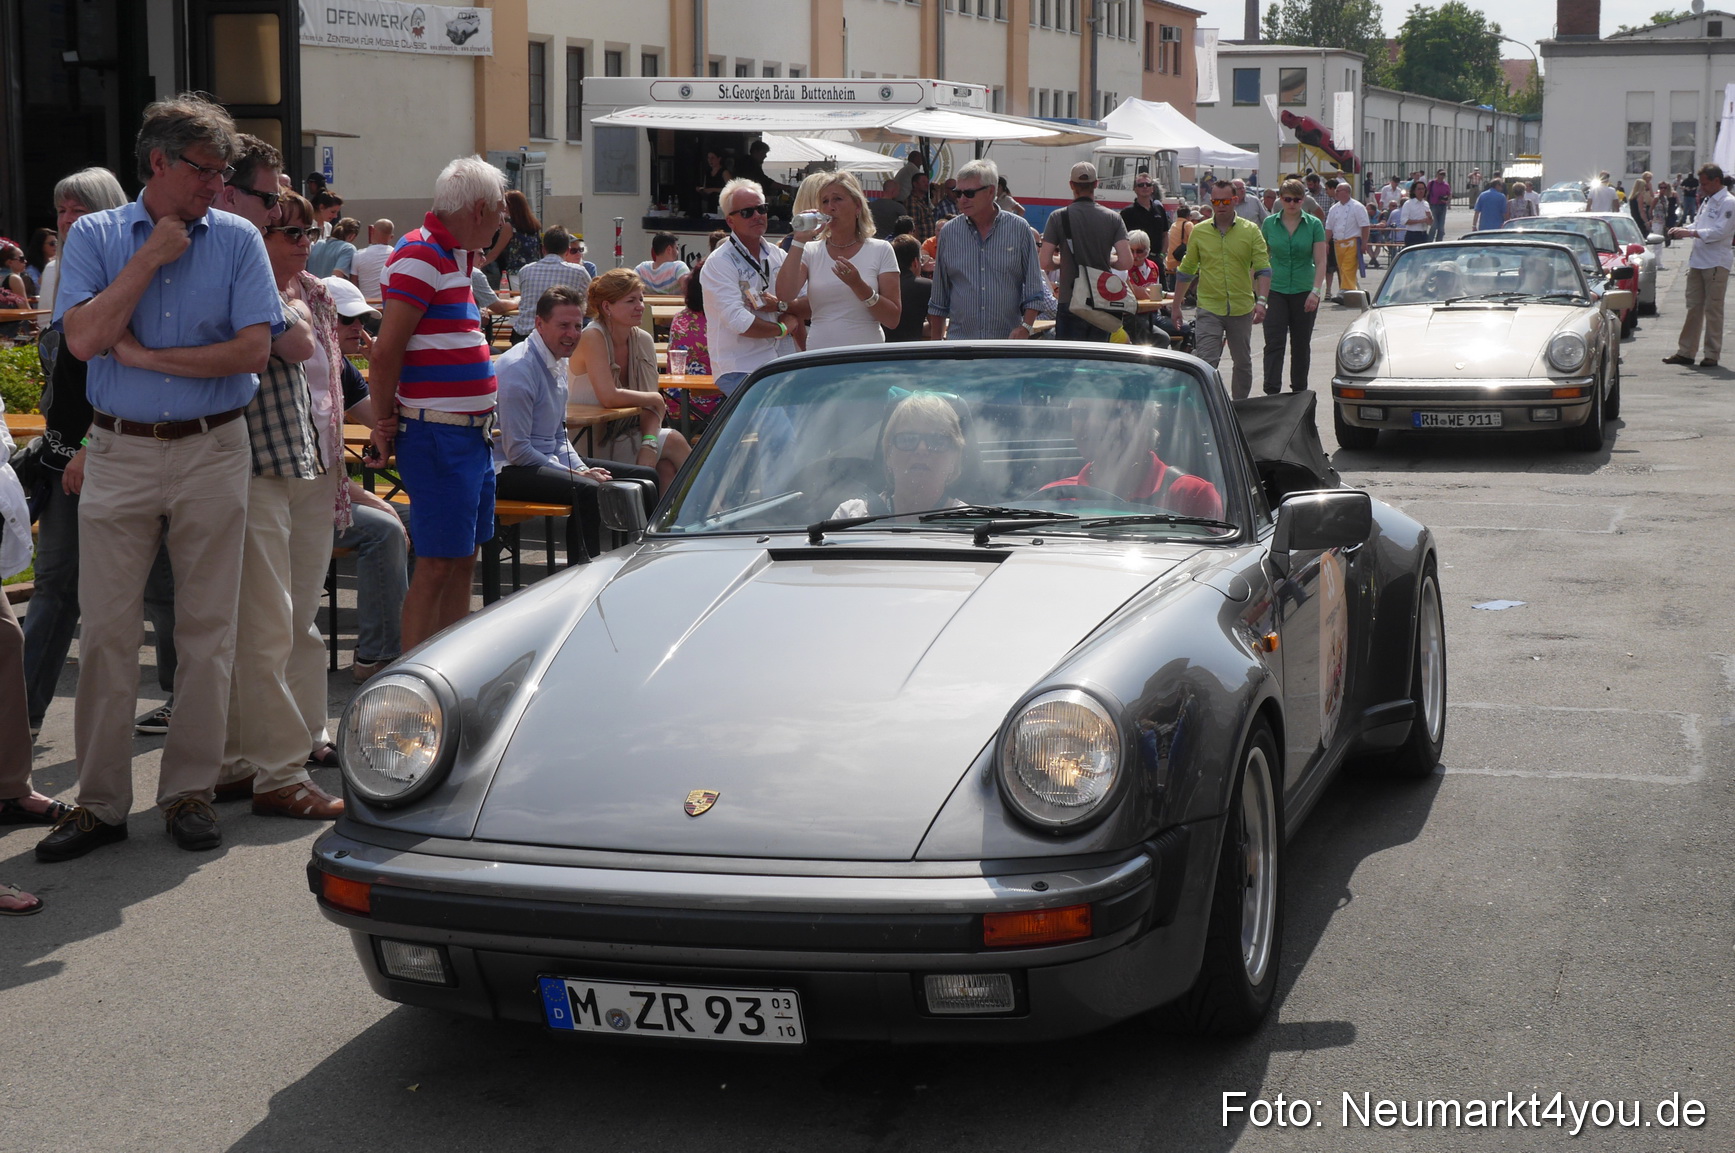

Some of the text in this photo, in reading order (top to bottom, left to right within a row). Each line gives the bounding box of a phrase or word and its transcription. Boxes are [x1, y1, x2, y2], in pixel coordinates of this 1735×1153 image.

[327, 8, 409, 31] OFENWERK
[327, 33, 359, 44] ZENTRUM
[361, 35, 374, 46] FÜR
[375, 38, 399, 48] MOBILE
[401, 39, 427, 50] CLASSIC
[773, 84, 795, 100] Bräu
[801, 84, 856, 100] Buttenheim
[324, 148, 331, 164] P
[1421, 414, 1493, 426] RH WE 911
[567, 986, 765, 1036] M ZR 93
[772, 997, 792, 1009] 03
[554, 1008, 564, 1019] D
[777, 1026, 796, 1037] 10
